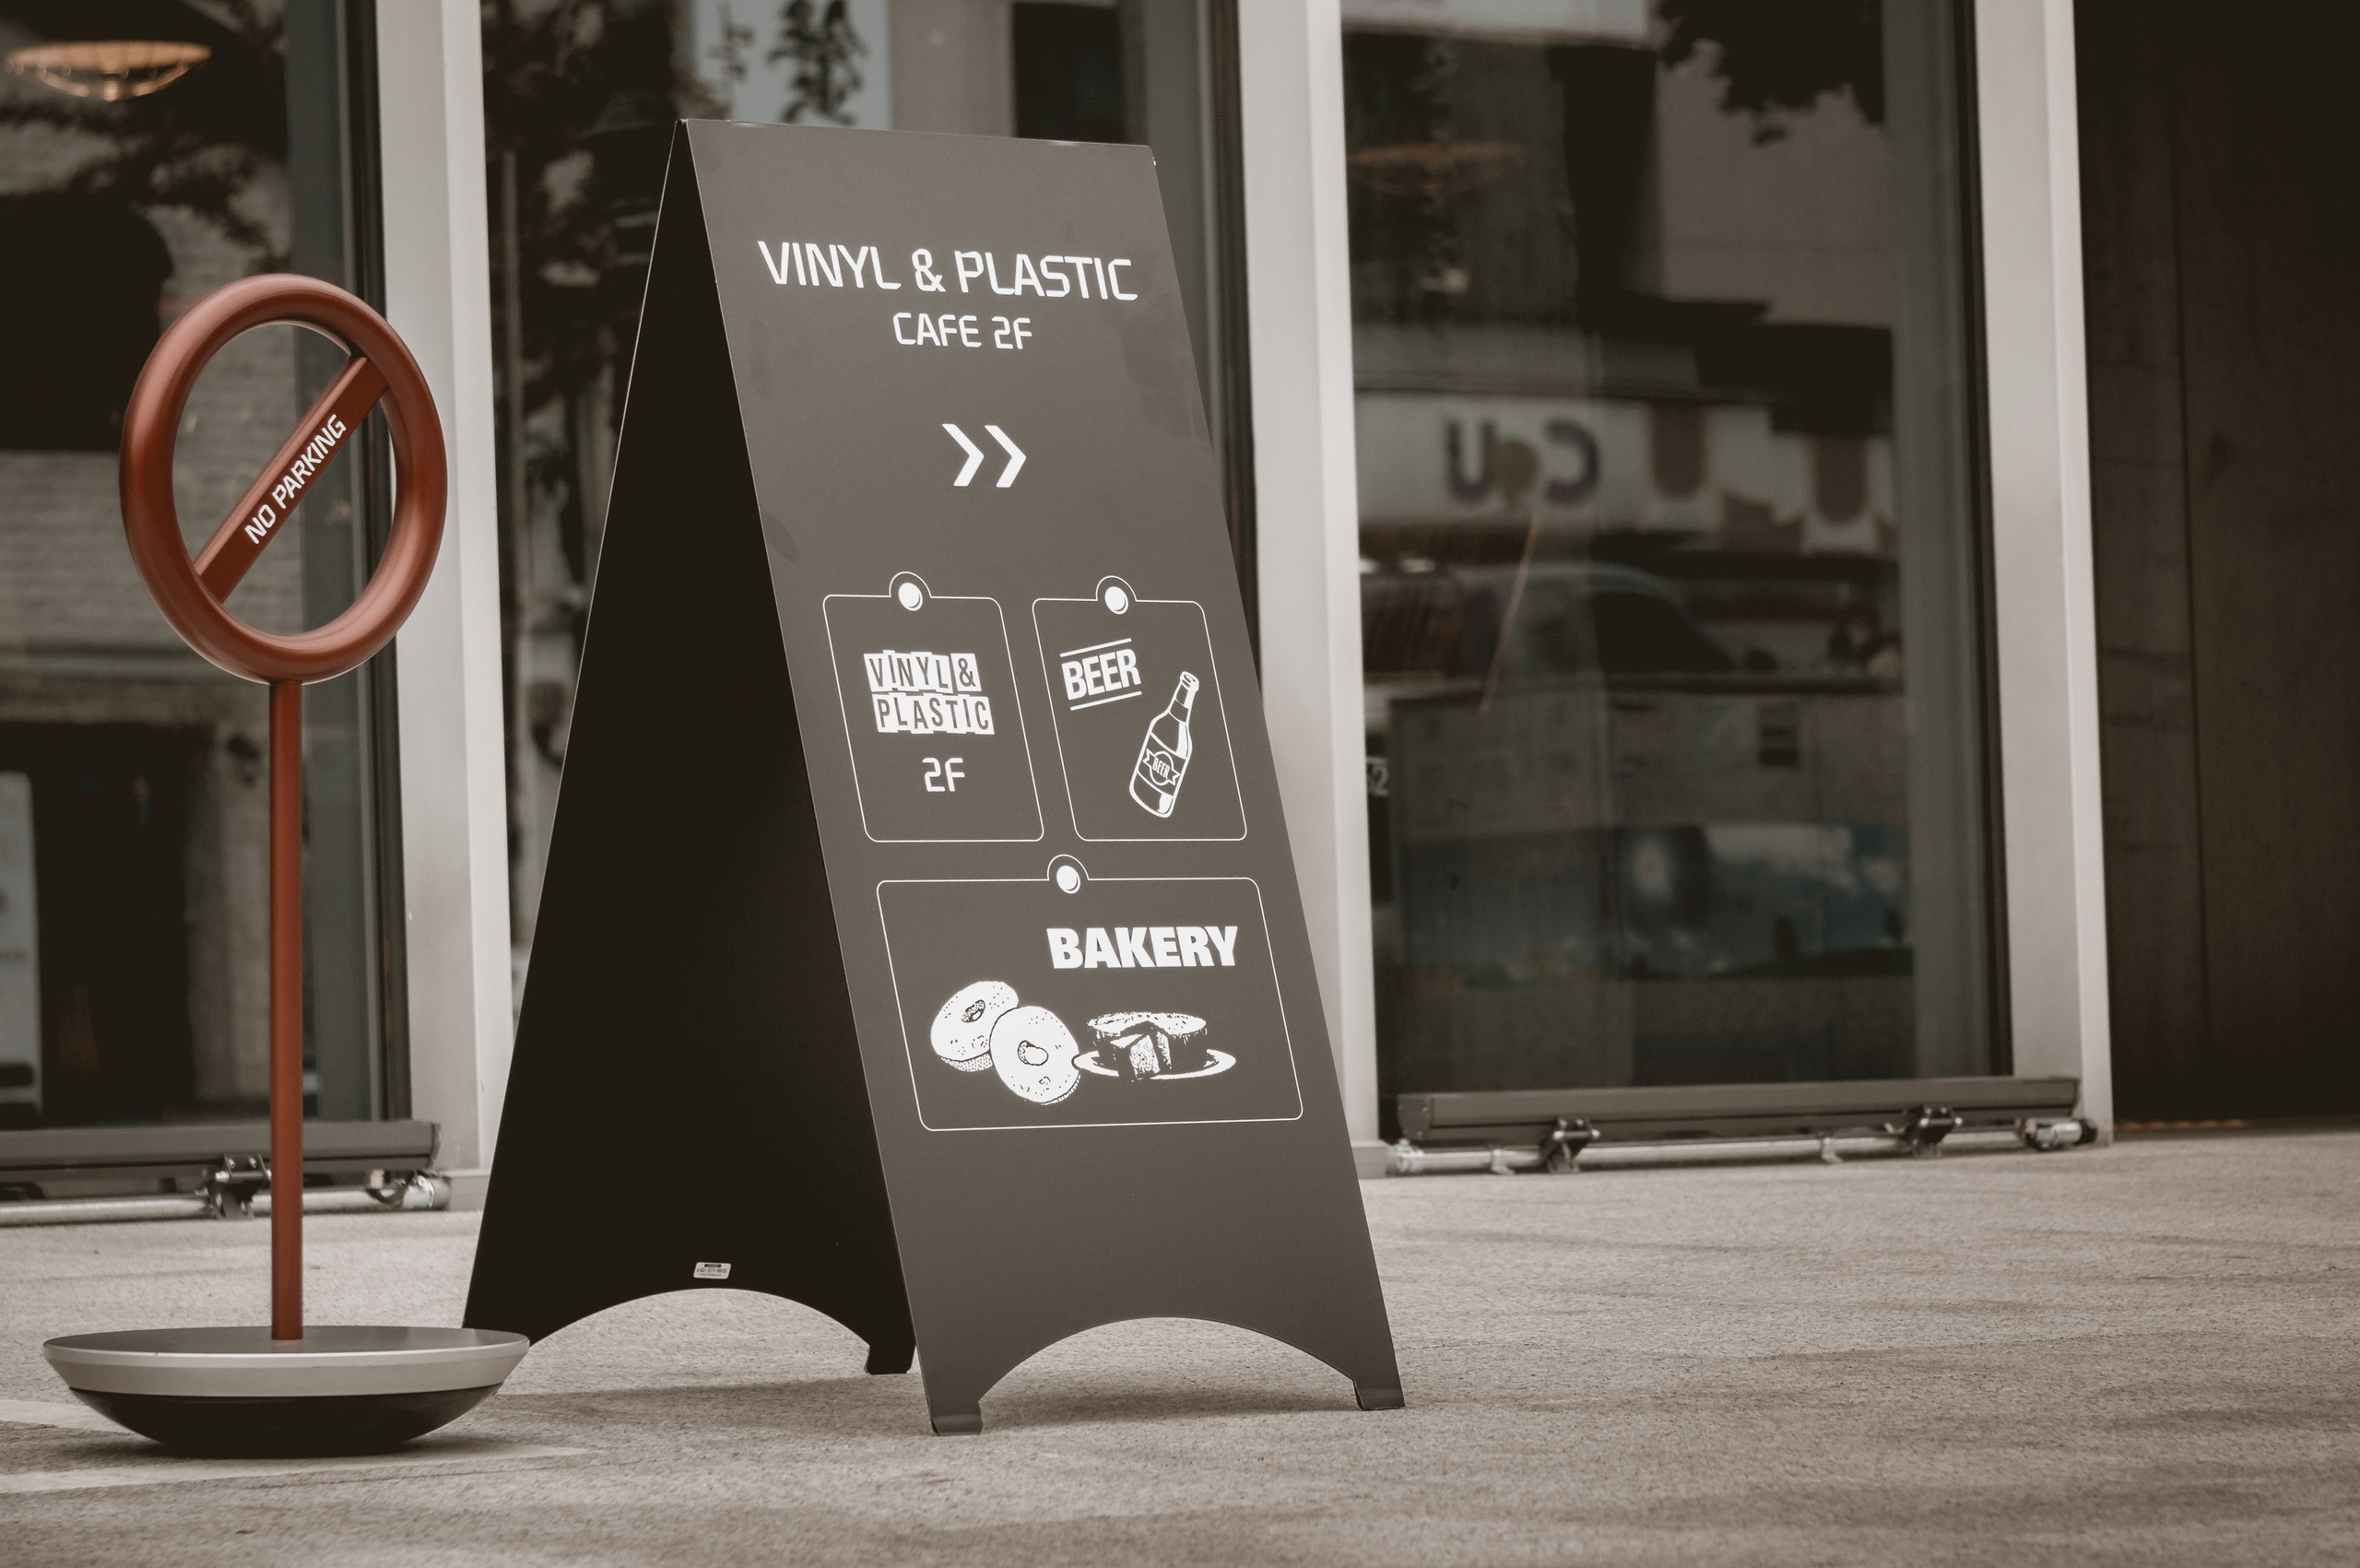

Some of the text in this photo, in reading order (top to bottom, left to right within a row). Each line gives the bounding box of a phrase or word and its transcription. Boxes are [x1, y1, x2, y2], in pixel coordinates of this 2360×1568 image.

[757, 240, 1139, 301] VINYL & PLASTIC
[892, 312, 1032, 350] CAFE 2F
[244, 414, 347, 545] NO PARKING
[867, 653, 978, 690] VINYL &
[1061, 648, 1142, 701] BEER
[876, 695, 991, 732] PLASTIC
[922, 757, 965, 793] 2F
[1152, 757, 1171, 779] BEER
[1045, 925, 1238, 970] BAKERY
